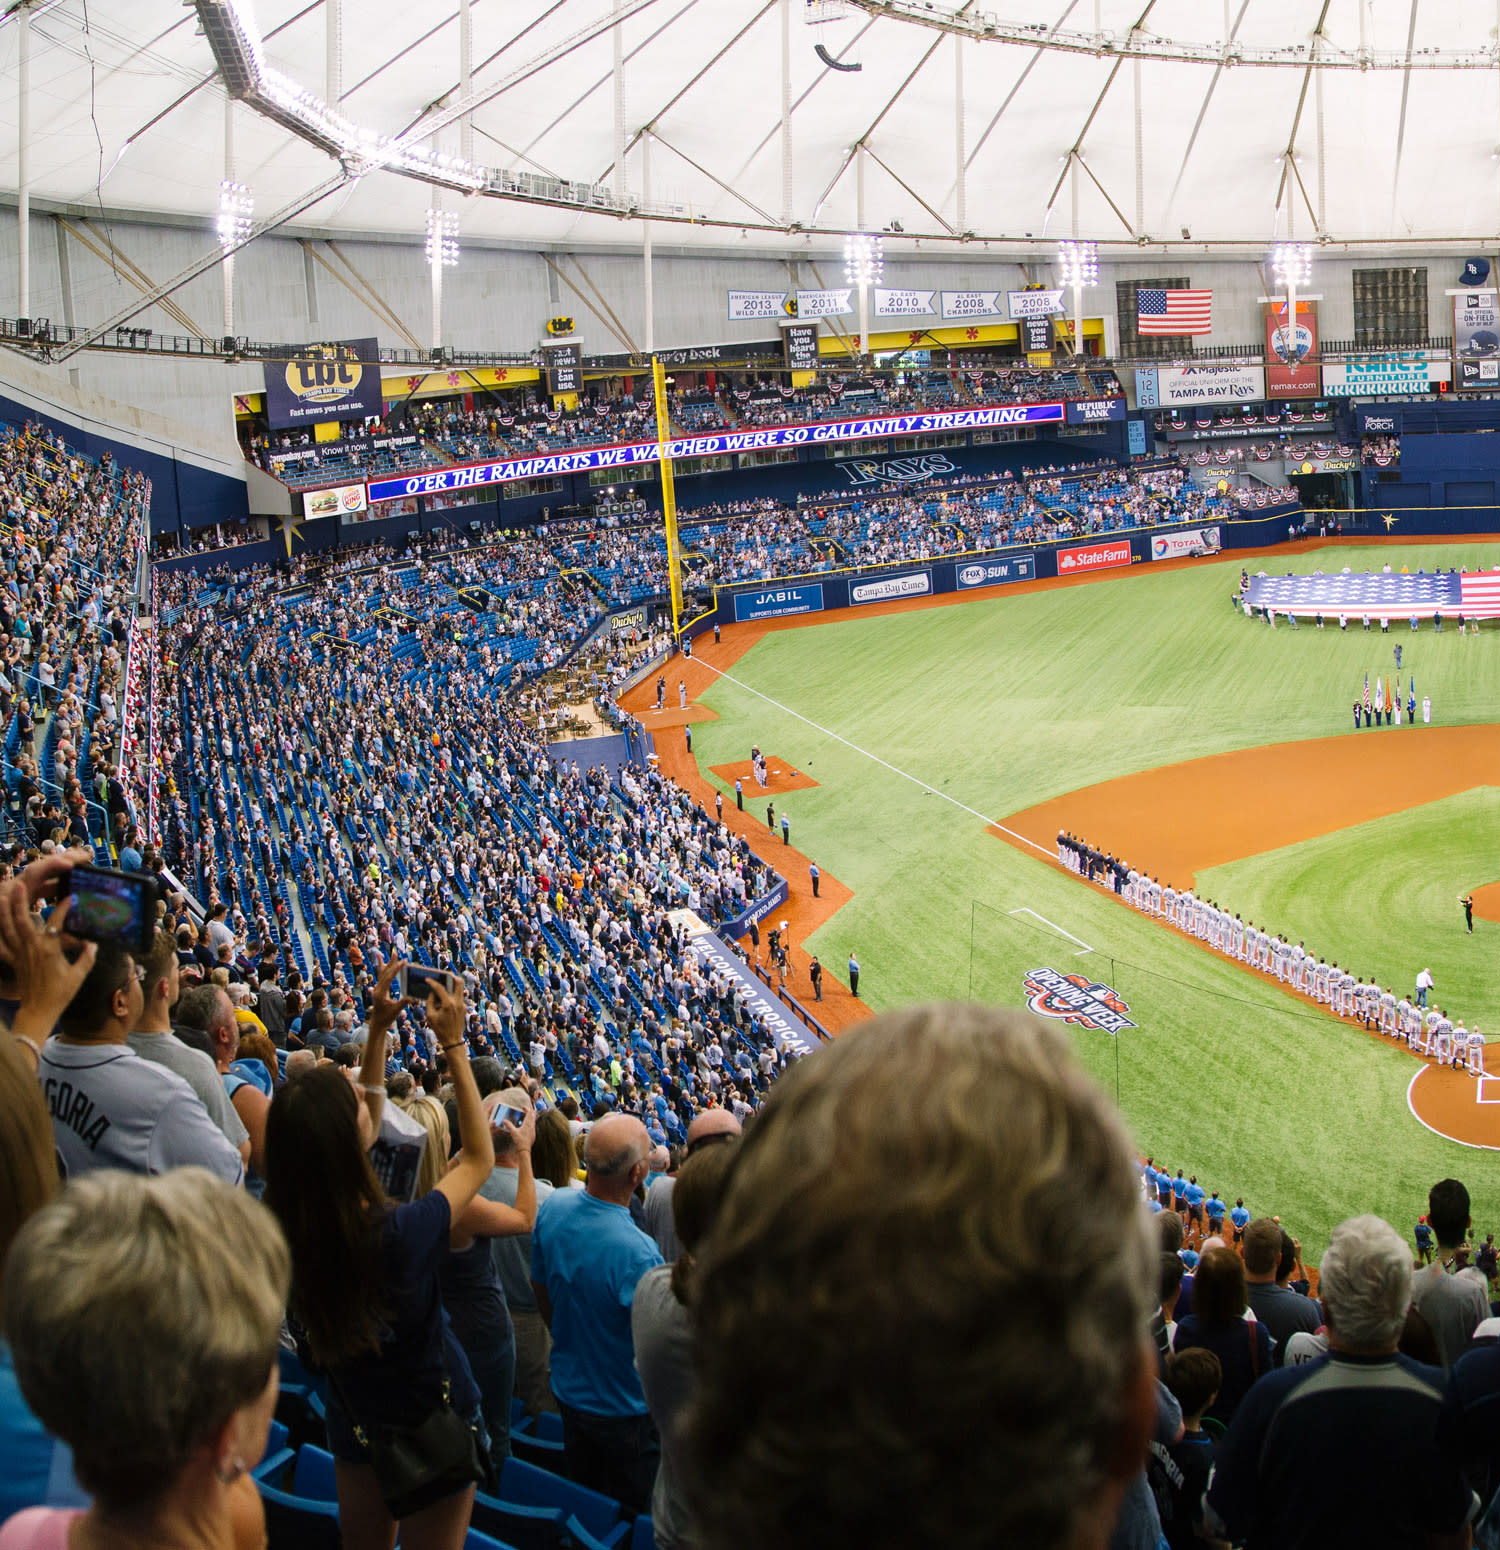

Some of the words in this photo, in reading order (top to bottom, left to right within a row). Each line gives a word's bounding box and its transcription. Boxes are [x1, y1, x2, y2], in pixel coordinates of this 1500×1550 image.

[744, 301, 772, 310] 2013
[811, 299, 838, 309] 2011
[888, 298, 918, 307] 2010
[955, 299, 985, 308] 2008
[1022, 298, 1050, 308] 2008
[1014, 306, 1058, 315] CHAMPIONS
[1030, 328, 1046, 336] you
[793, 337, 810, 345] you
[1030, 341, 1048, 349] use.
[690, 347, 720, 359] Deck
[790, 344, 815, 352] heard
[1349, 373, 1425, 381] FURNITURE
[558, 382, 575, 390] use.
[1142, 380, 1153, 391] 12
[1271, 382, 1316, 390] remax.com
[1170, 389, 1206, 398] TAMPA
[1208, 387, 1228, 396] BAY
[1229, 384, 1255, 397] RAYS
[1141, 394, 1155, 406] 66
[290, 408, 304, 417] Fast
[305, 407, 323, 415] news
[324, 406, 336, 416] you
[337, 404, 349, 412] can
[350, 402, 364, 411] use.
[1077, 401, 1116, 411] REPUBLIC
[1085, 409, 1109, 418] BANK
[1365, 422, 1394, 430] PORCH
[1212, 428, 1248, 437] Petersburg
[322, 446, 343, 456] Know
[351, 443, 368, 453] now.
[406, 475, 447, 494] O'ER
[452, 468, 486, 486] THE
[490, 454, 591, 480] RAMPARTS
[597, 452, 626, 467] WE
[632, 438, 720, 461] WATCHED
[726, 432, 778, 449] WERE
[782, 429, 808, 443] SO
[813, 416, 917, 440] GALLANTLY
[920, 408, 1028, 430] STREAMING
[835, 454, 956, 485] RAYS
[1325, 460, 1355, 471] Ducky's
[1206, 467, 1235, 477] Ducky's
[346, 494, 361, 507] KING
[1172, 539, 1201, 548] TOTAL
[965, 569, 981, 577] FOX
[987, 564, 1008, 577] SUN
[856, 585, 883, 599] Tampa
[884, 582, 901, 595] Bay
[901, 580, 926, 592] Times
[756, 591, 802, 604] JABIL
[750, 610, 772, 619] SUPPORTS
[782, 605, 810, 615] COMMUNITY
[611, 609, 643, 630] Ducky's
[692, 936, 745, 982] WELCOME
[741, 984, 758, 999] TO
[751, 1000, 814, 1054] TROPICAN
[1027, 968, 1093, 1008] OPENING
[1081, 1003, 1136, 1033] WEEK
[45, 1078, 111, 1151] GORIA
